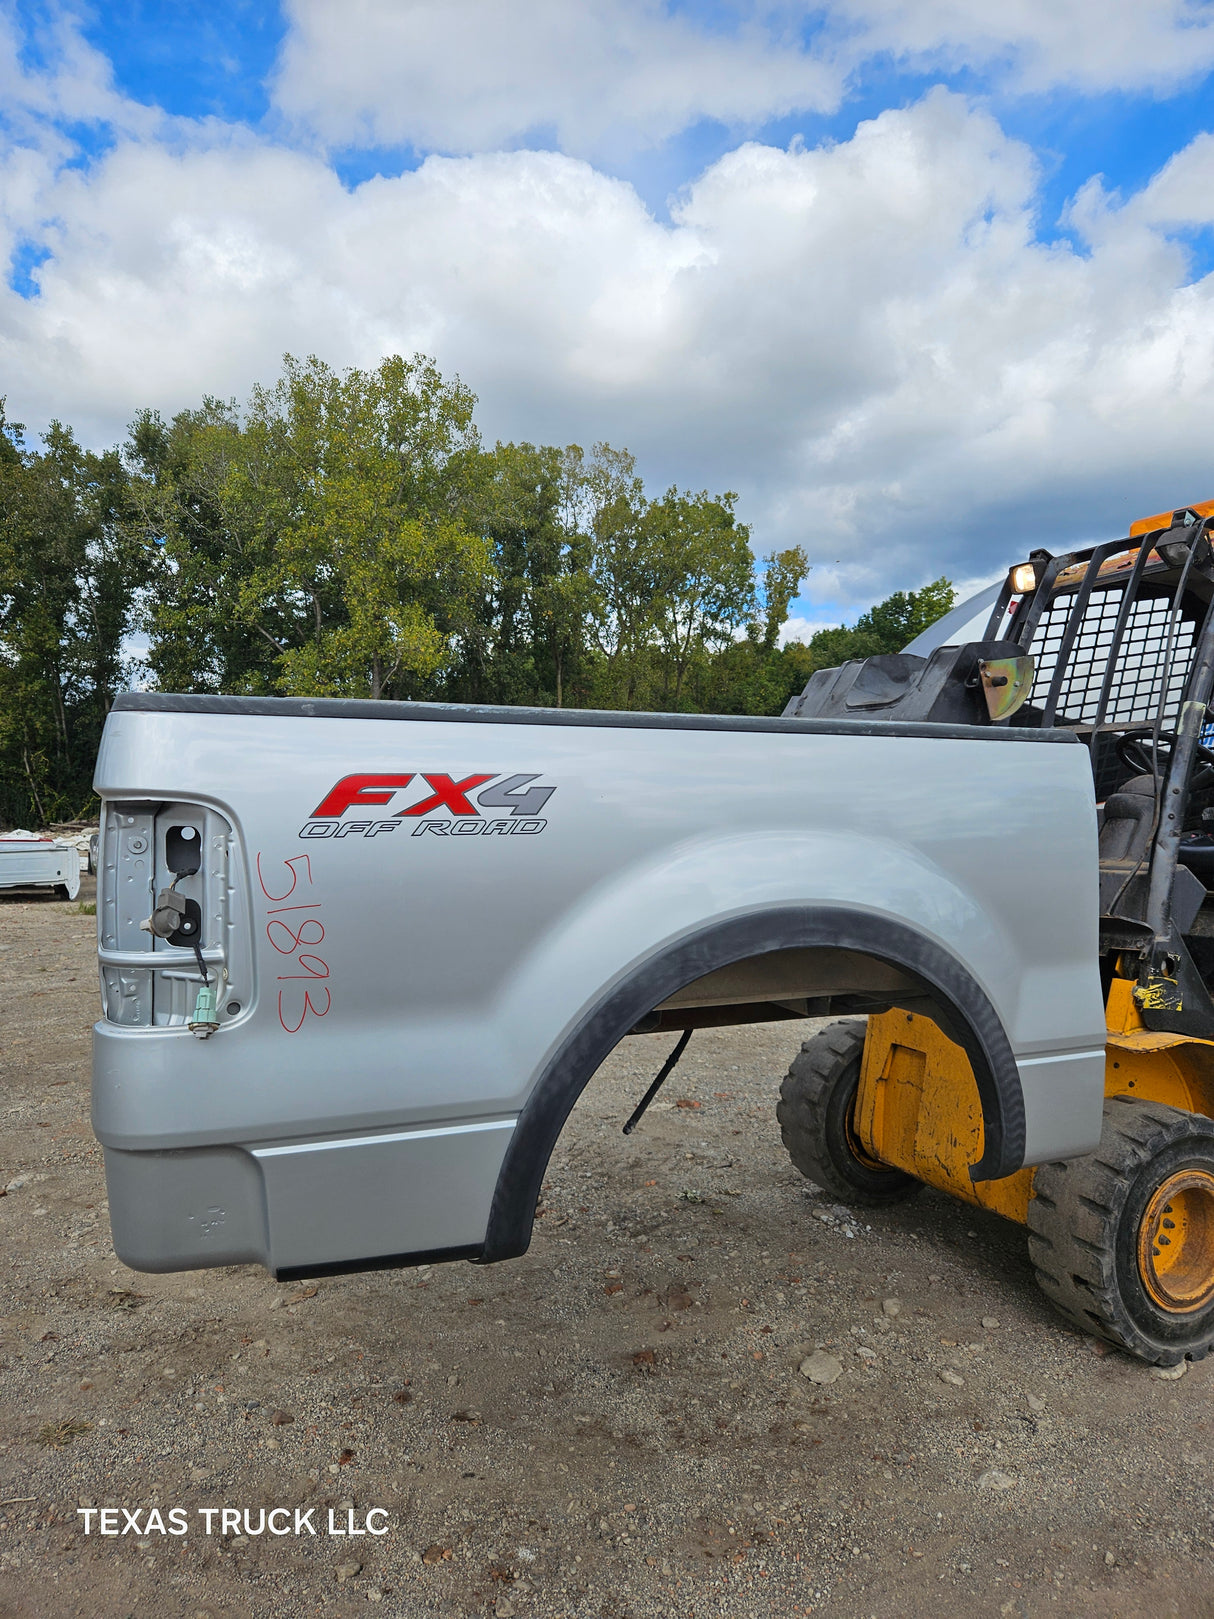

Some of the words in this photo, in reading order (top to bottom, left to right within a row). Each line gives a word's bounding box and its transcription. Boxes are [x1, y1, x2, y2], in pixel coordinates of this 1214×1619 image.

[309, 773, 557, 818] FX4
[299, 820, 402, 838] OFF
[411, 819, 547, 836] ROAD
[257, 852, 331, 1033] 51893
